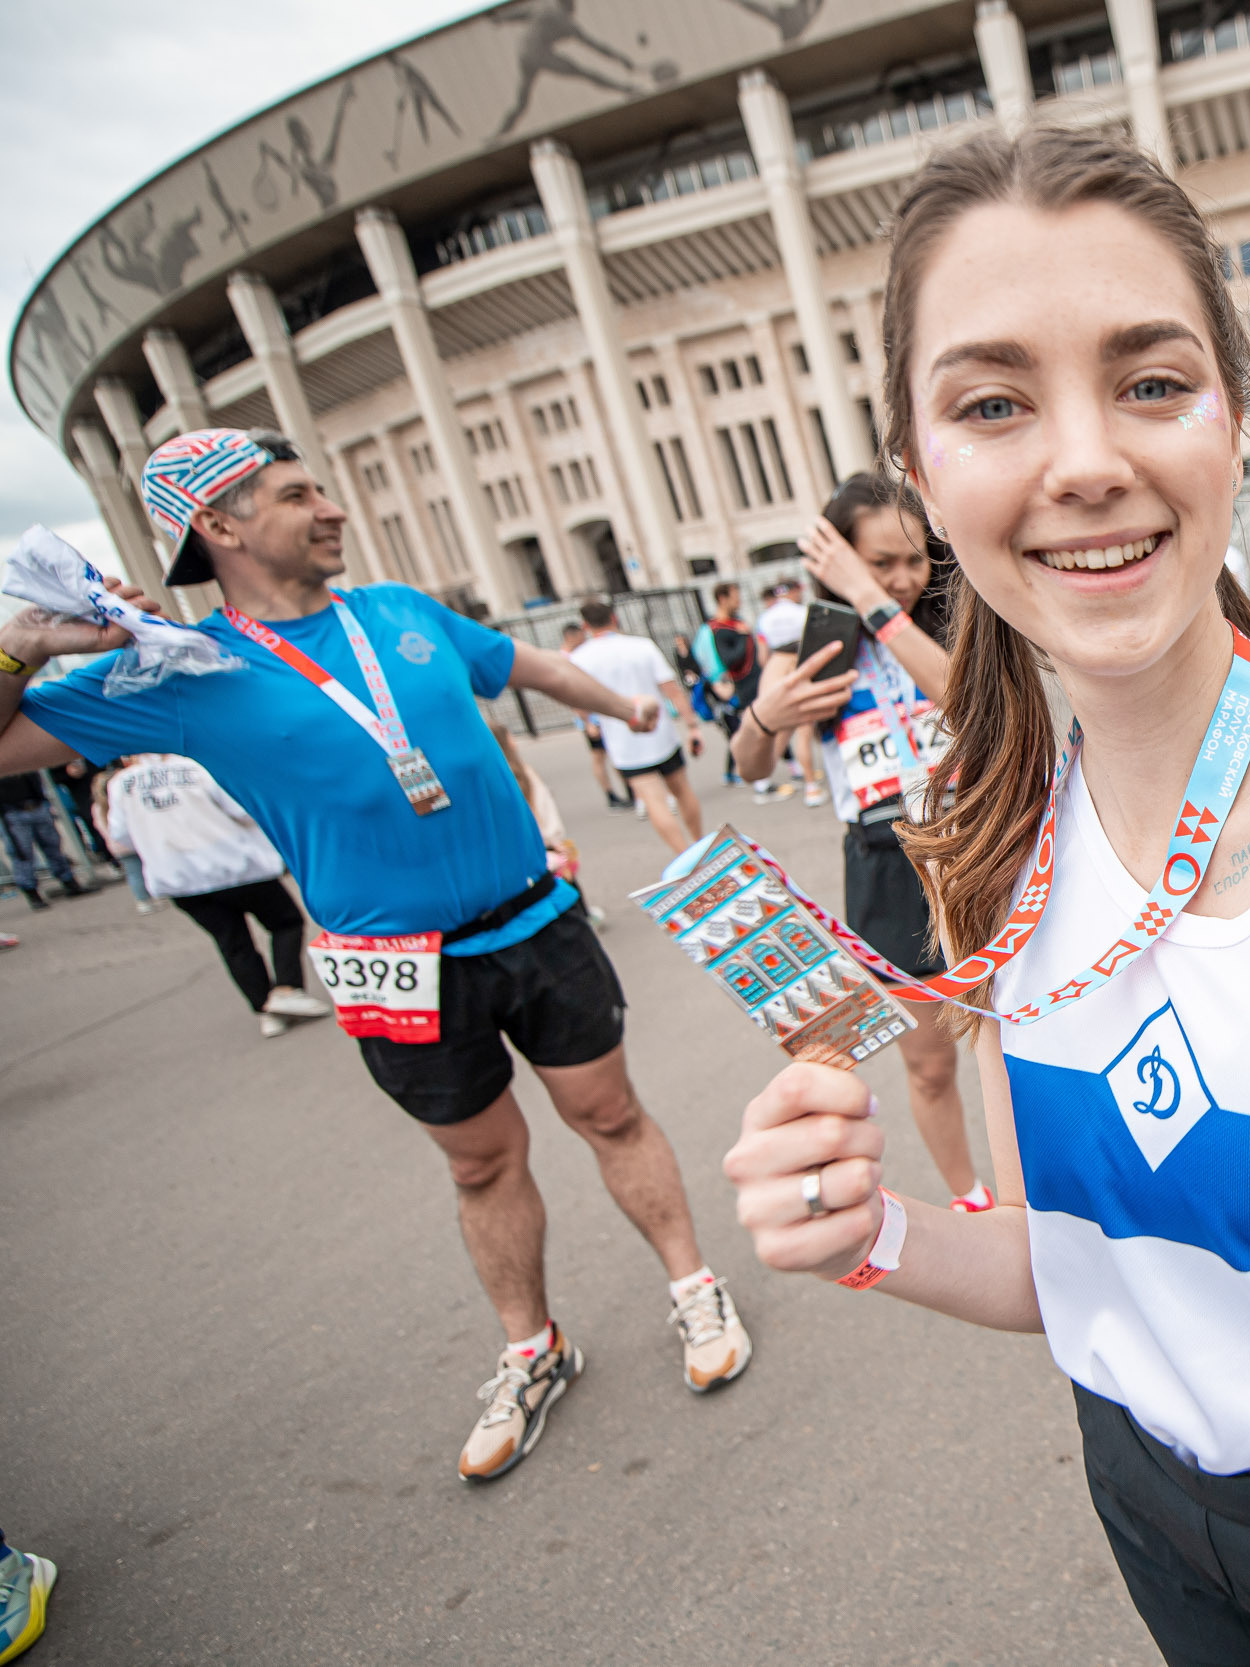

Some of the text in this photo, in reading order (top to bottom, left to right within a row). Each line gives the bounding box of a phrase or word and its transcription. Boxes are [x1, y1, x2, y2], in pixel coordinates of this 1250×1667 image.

[1203, 688, 1238, 761] МАРАФОН
[1230, 694, 1250, 736] ПОЛУ
[324, 956, 418, 991] 3398
